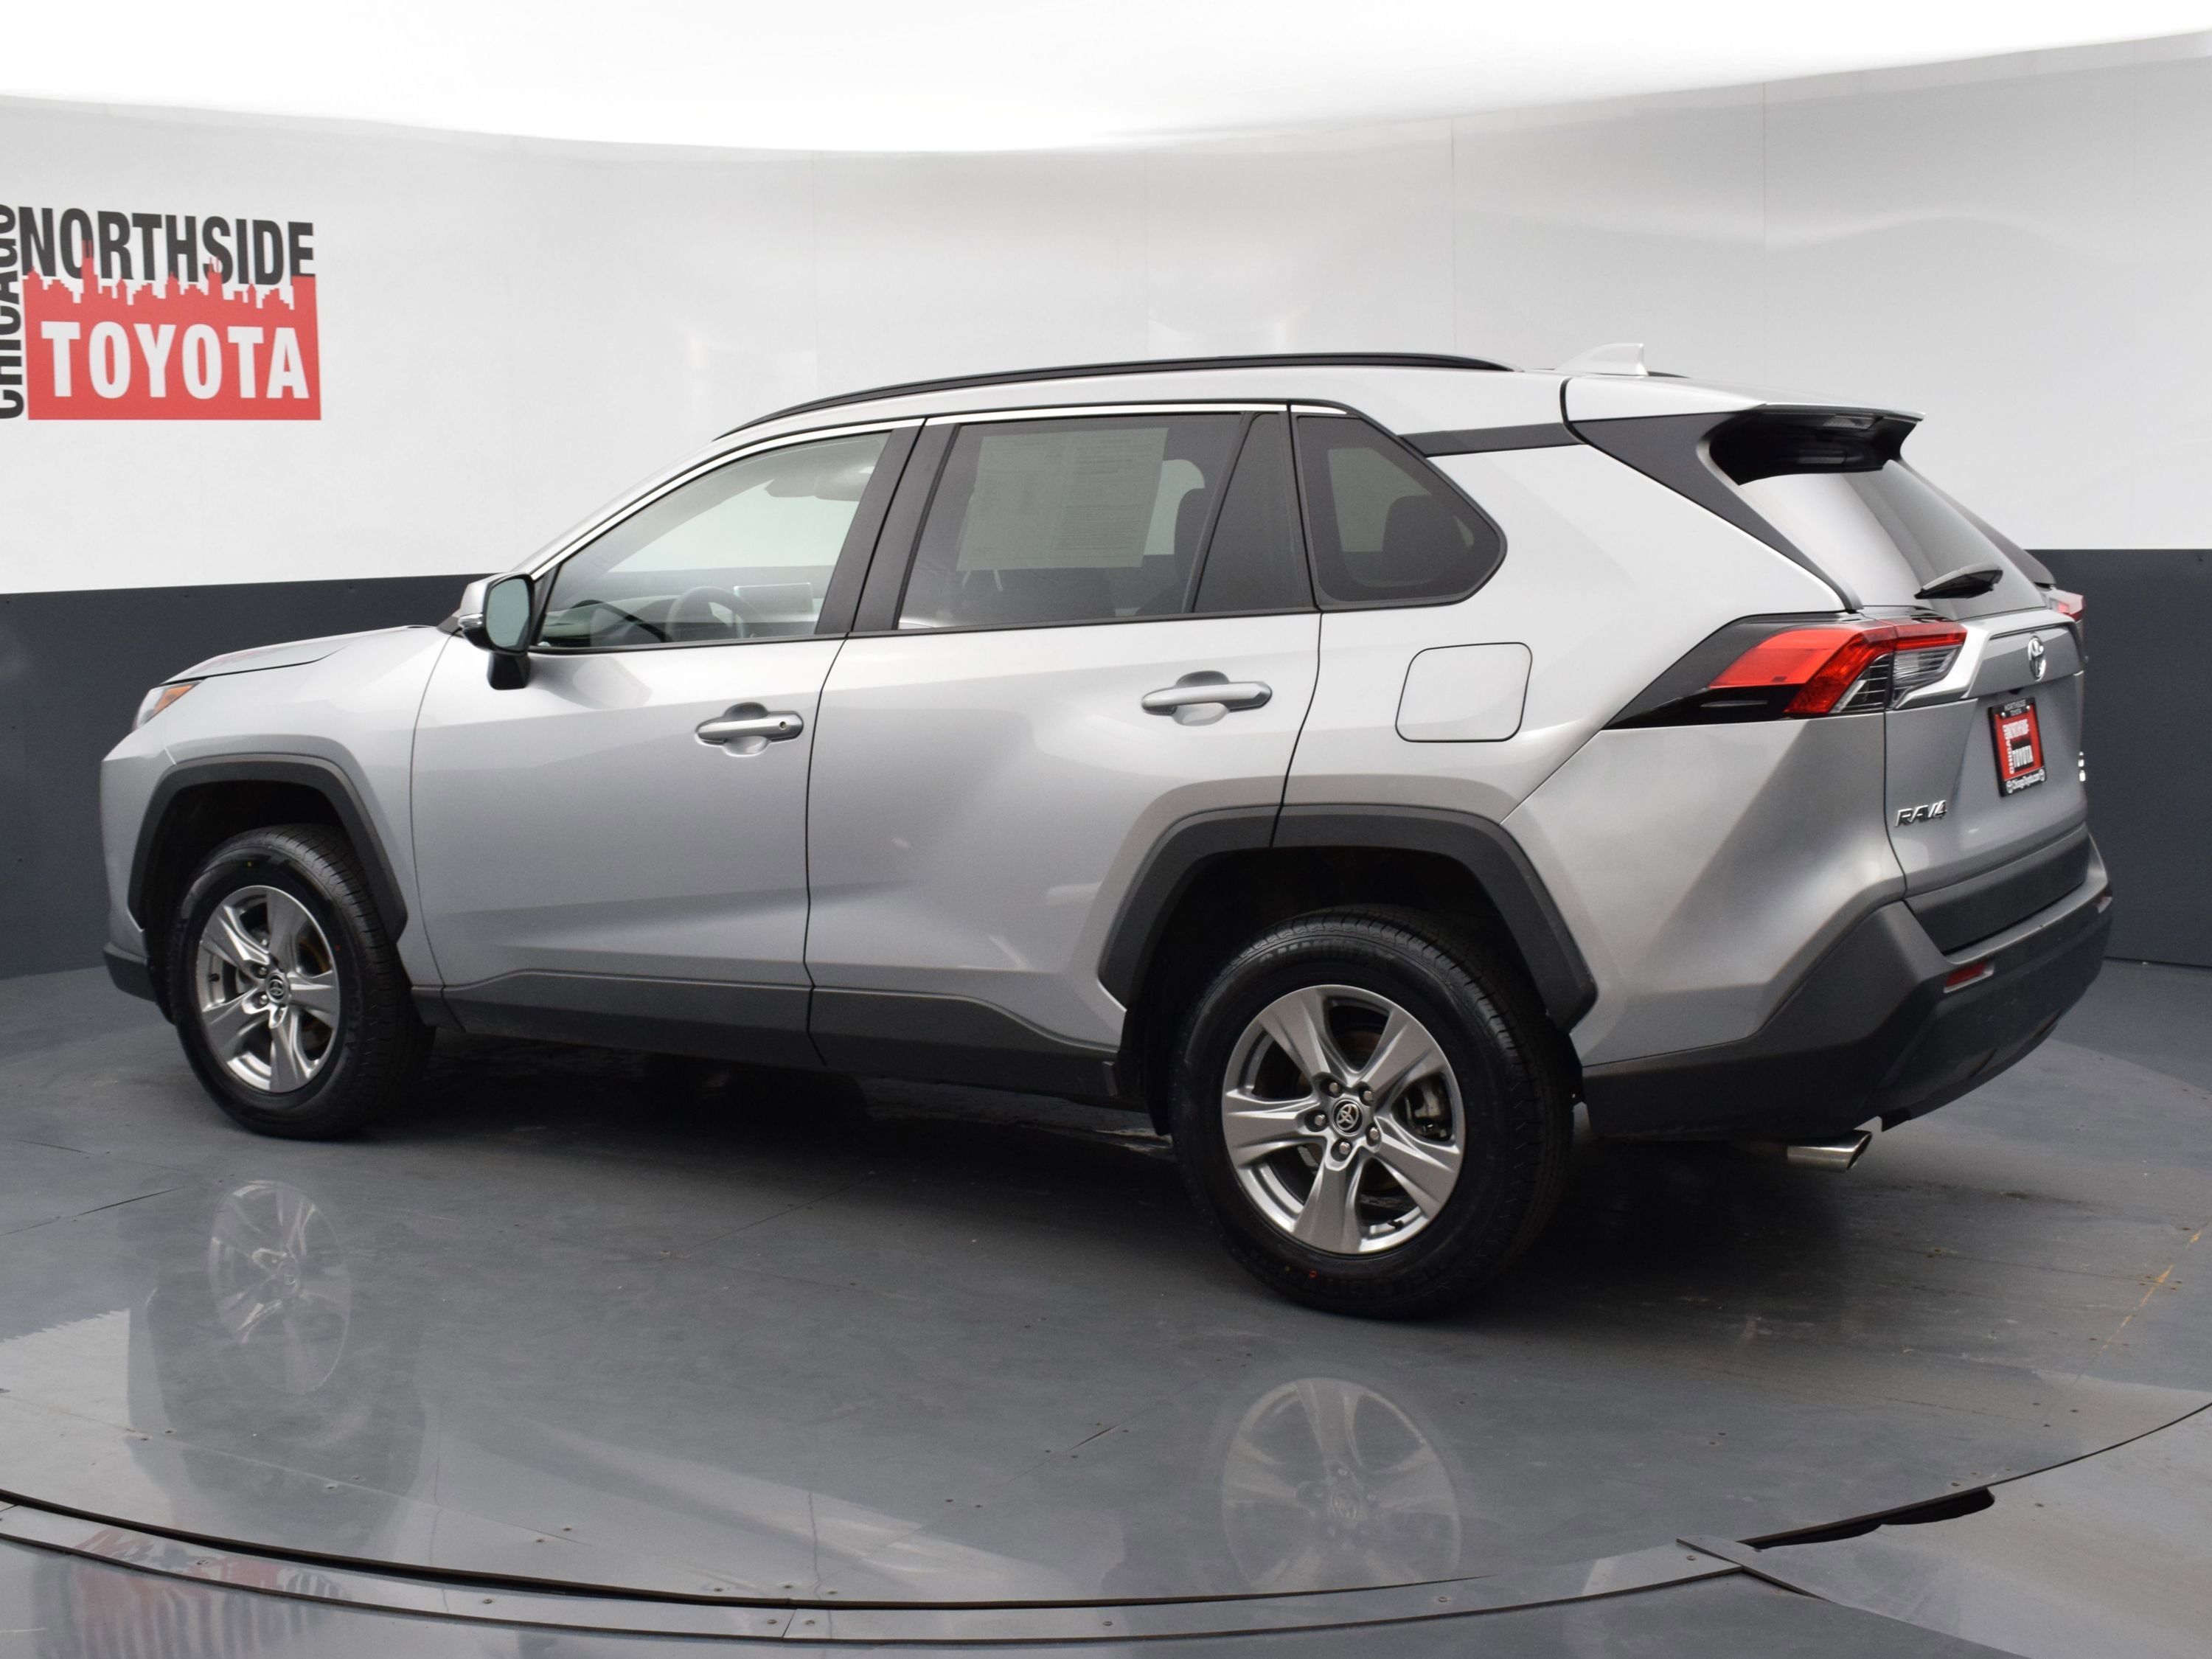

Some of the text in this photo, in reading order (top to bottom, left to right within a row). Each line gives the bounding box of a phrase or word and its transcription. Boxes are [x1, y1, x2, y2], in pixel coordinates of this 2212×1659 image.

[18, 206, 315, 286] NORTHSIDE
[41, 320, 310, 400] TOYOTA
[1894, 799, 1947, 827] RAV4
